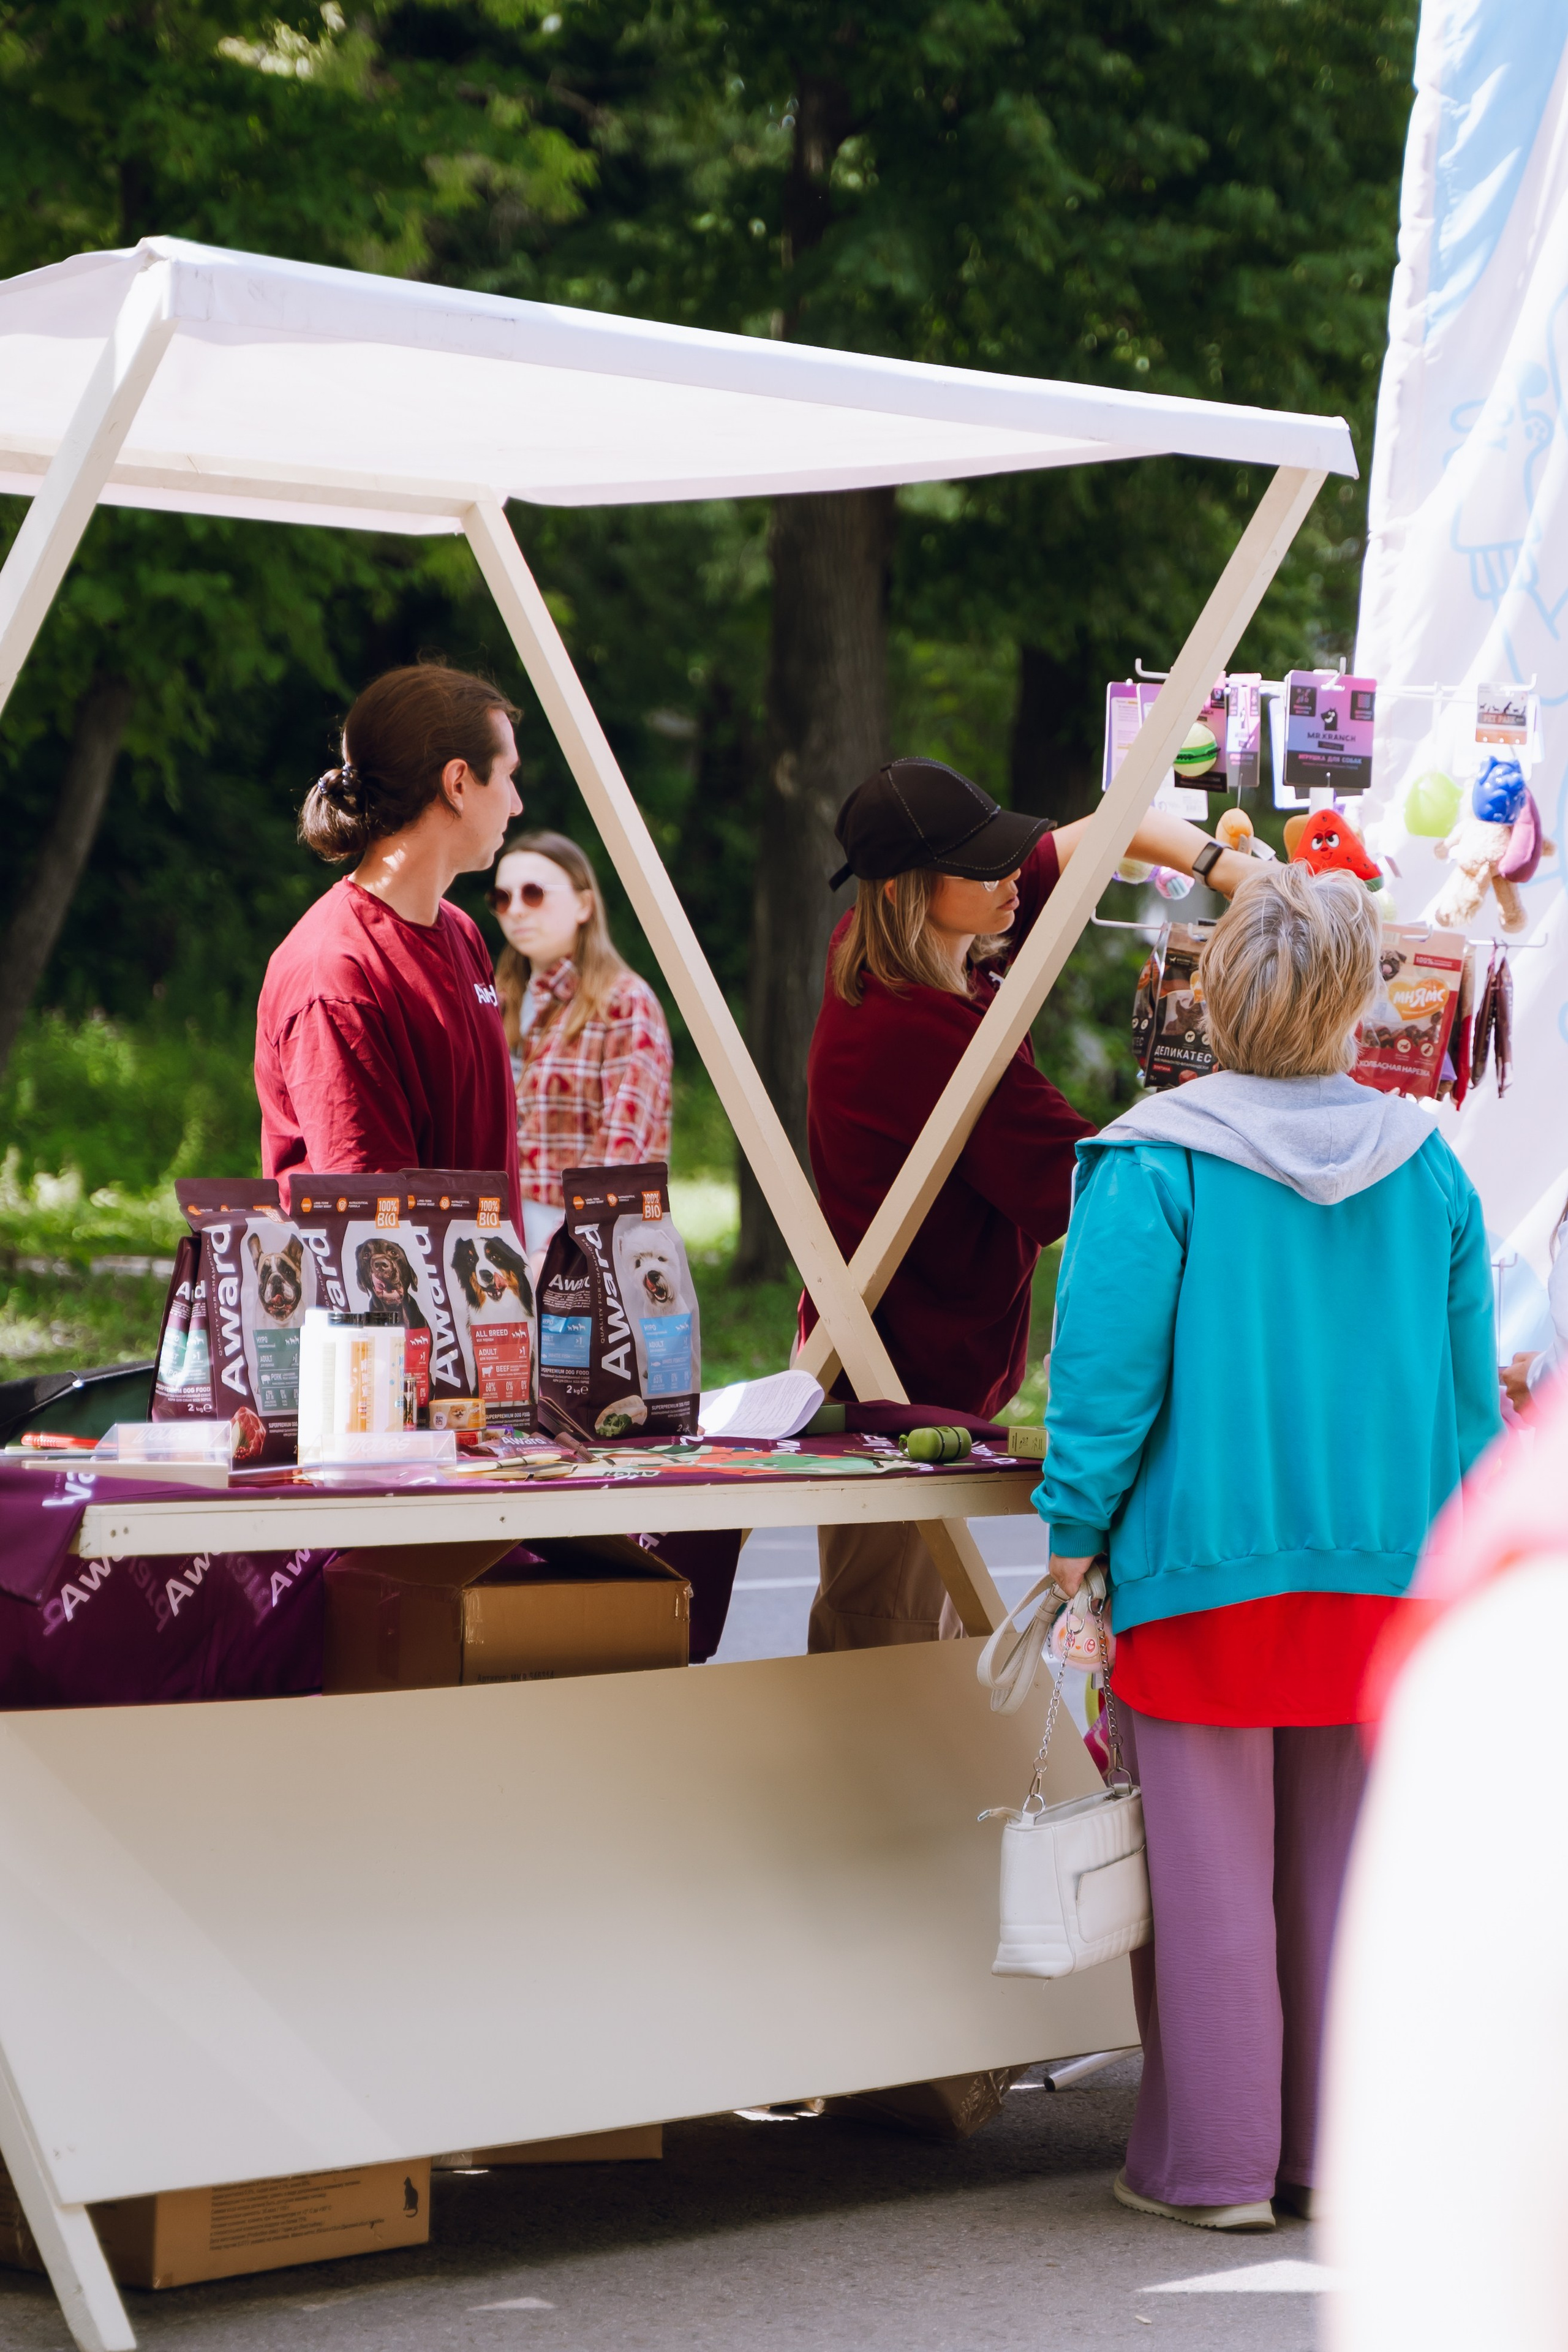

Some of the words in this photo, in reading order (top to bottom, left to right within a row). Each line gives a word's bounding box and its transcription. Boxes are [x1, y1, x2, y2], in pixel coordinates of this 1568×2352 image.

[1154, 1045, 1212, 1063] ДЕЛИКАТЕС
[379, 1200, 398, 1212] 100%
[480, 1200, 499, 1212] 100%
[643, 1194, 660, 1205] 100%
[644, 1204, 661, 1219] BIO
[377, 1213, 396, 1226] BIO
[479, 1212, 497, 1226] BIO
[411, 1226, 461, 1389] Award
[575, 1224, 631, 1381] Award
[202, 1224, 247, 1396] Award
[566, 1385, 573, 1393] 2
